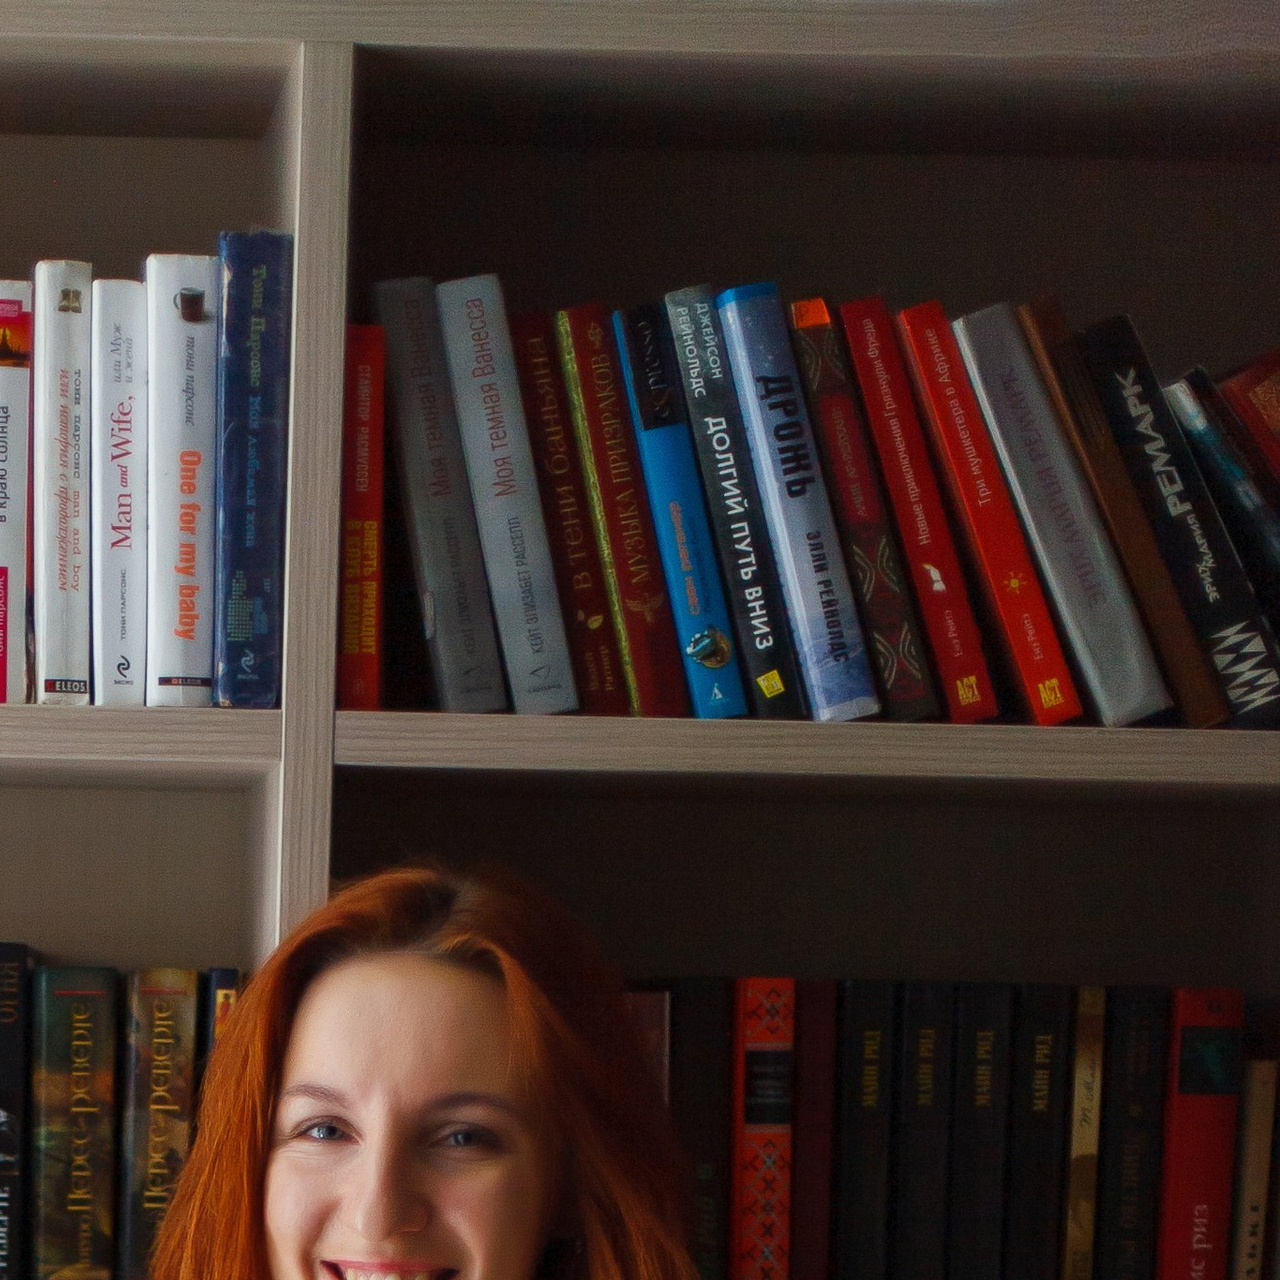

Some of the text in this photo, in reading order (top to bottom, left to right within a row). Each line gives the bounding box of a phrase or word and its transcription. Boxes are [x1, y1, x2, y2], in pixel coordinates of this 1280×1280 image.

[463, 298, 518, 497] Моя темная Ванесса
[674, 307, 707, 398] РЕЙНОЛЬДС
[694, 301, 723, 379] ДЖЕЙСОН
[110, 396, 136, 550] Man and Wife,
[755, 374, 816, 498] ДРОЖЬ
[923, 328, 993, 507] Три мушкетера Африке
[1115, 368, 1193, 518] РЕМАРК
[174, 450, 202, 641] One for my baby
[703, 415, 774, 650] ДОЛГИЙ ПУТЬ ВНИЗ
[1187, 1204, 1213, 1250] риз
